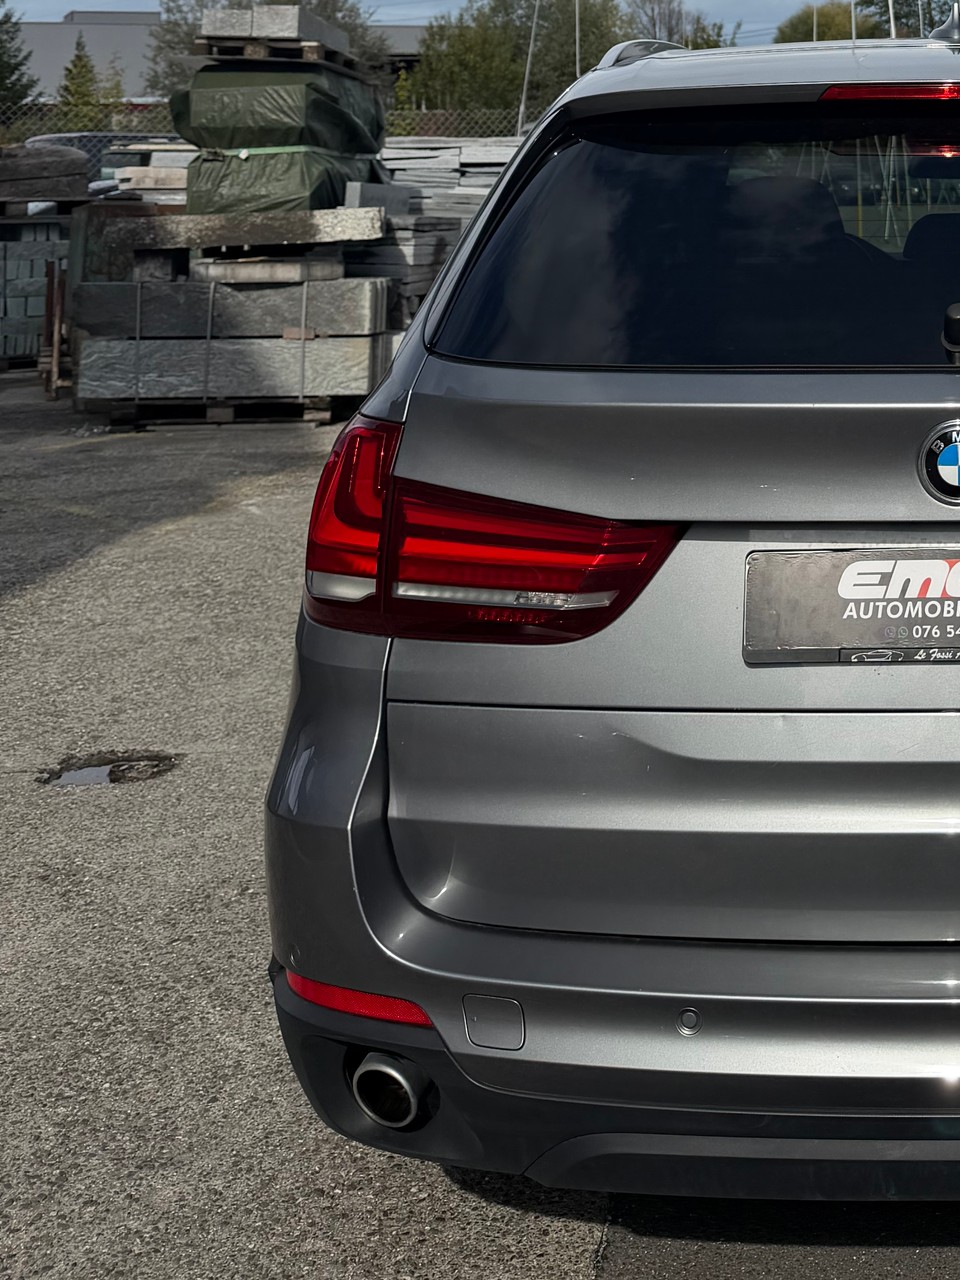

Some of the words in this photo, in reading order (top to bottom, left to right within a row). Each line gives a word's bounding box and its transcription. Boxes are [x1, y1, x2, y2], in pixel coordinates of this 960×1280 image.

[912, 625, 941, 638] 076
[914, 649, 927, 659] Le
[929, 648, 954, 660] Fossi
